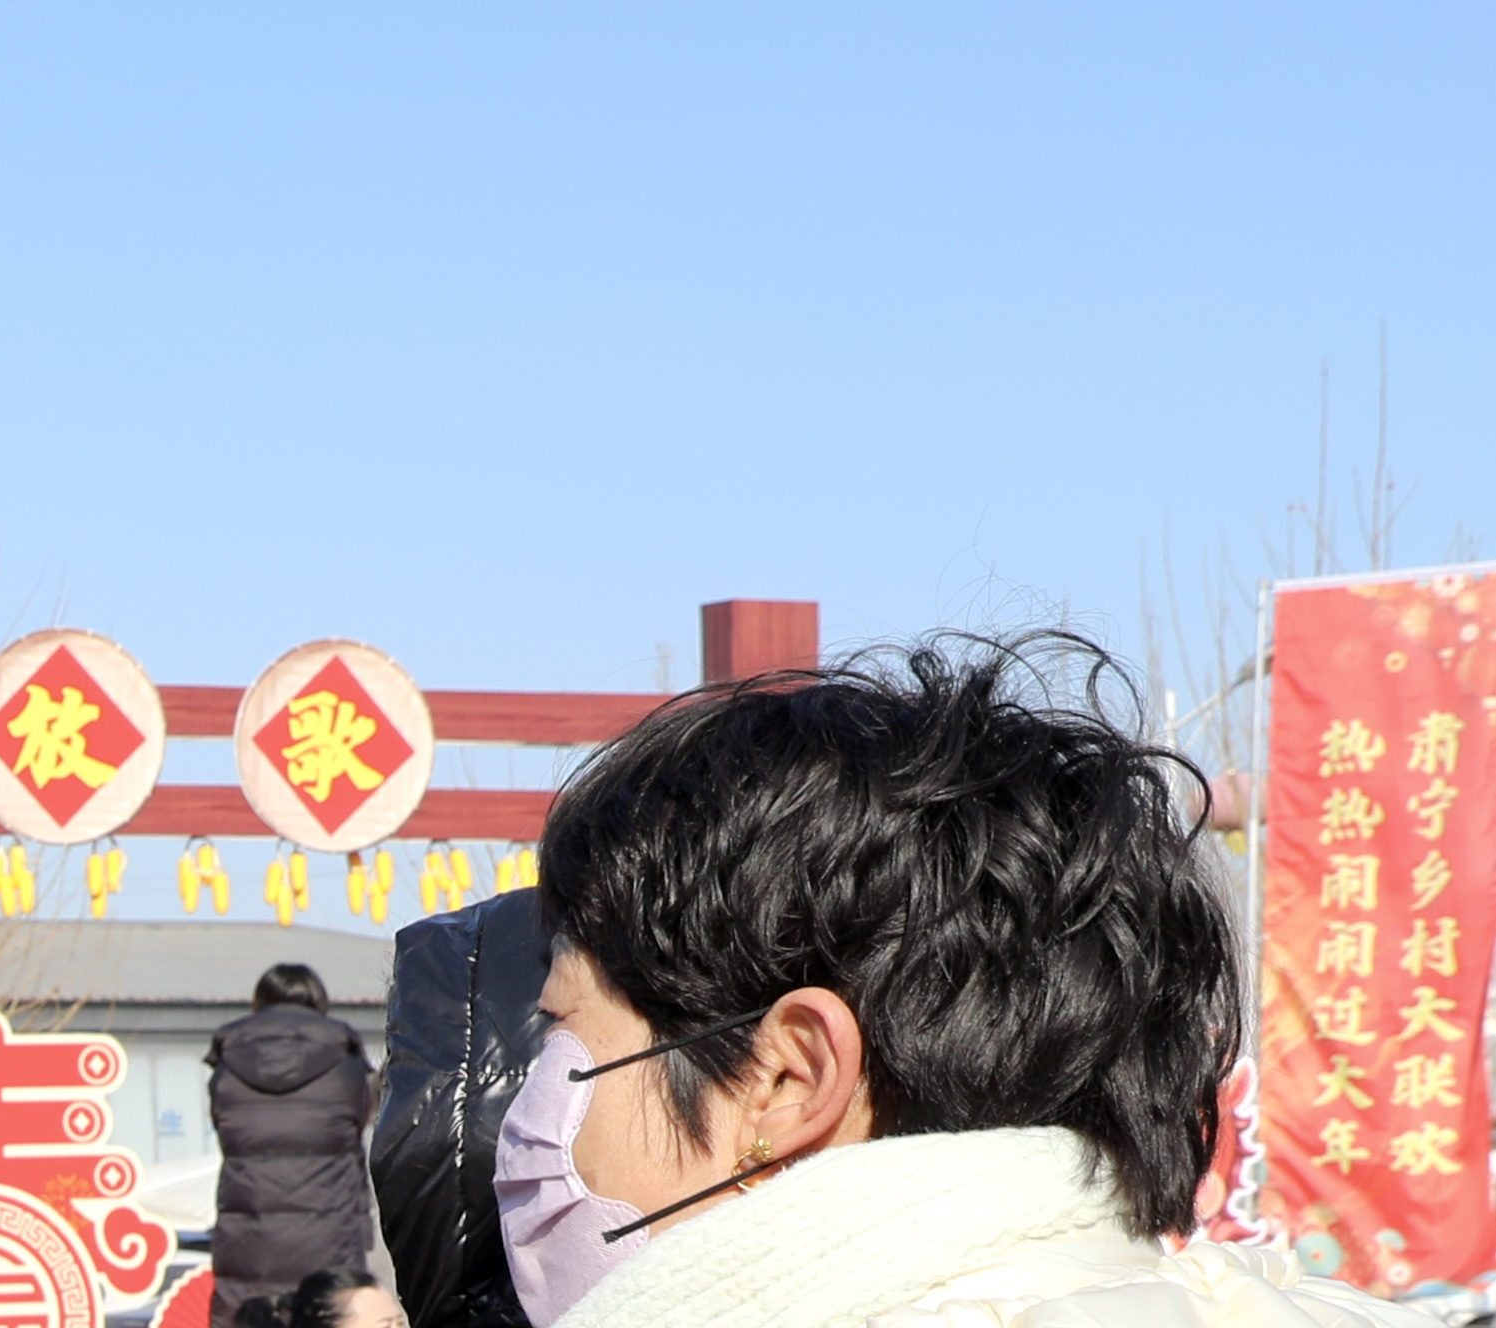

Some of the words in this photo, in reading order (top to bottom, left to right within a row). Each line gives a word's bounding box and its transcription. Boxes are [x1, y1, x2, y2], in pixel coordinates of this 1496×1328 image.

[1313, 719, 1387, 1175] 热热闹闹过大年
[1391, 711, 1465, 1175] 肃宁乡村大联欢
